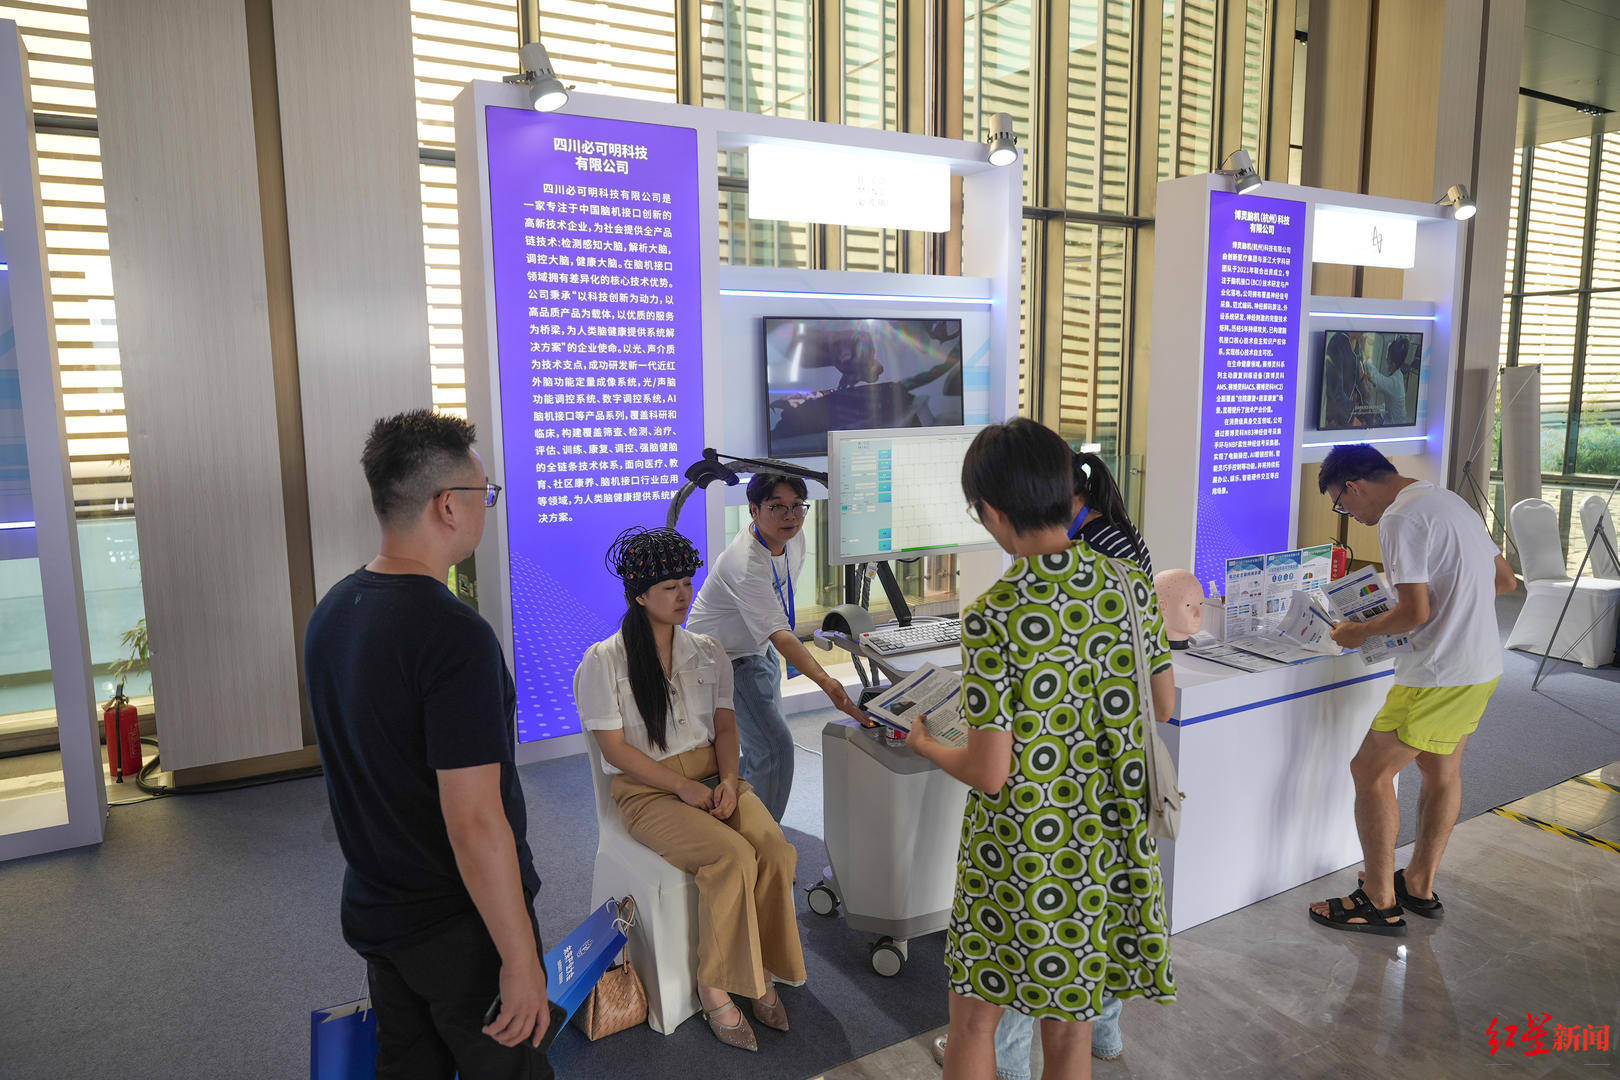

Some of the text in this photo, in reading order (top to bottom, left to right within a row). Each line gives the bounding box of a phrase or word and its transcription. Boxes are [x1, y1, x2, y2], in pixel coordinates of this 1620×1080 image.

[553, 137, 649, 161] 四川必可明科技
[575, 155, 629, 175] 有限公司
[542, 183, 672, 204] 四川必可明科技有限公司是
[523, 200, 672, 221] 一家专注于中国脑机接口创新的
[1249, 222, 1275, 236] 有限公司
[526, 270, 673, 289] 领域拥有差异化的核心技术优势。
[538, 512, 573, 524] 决方案。
